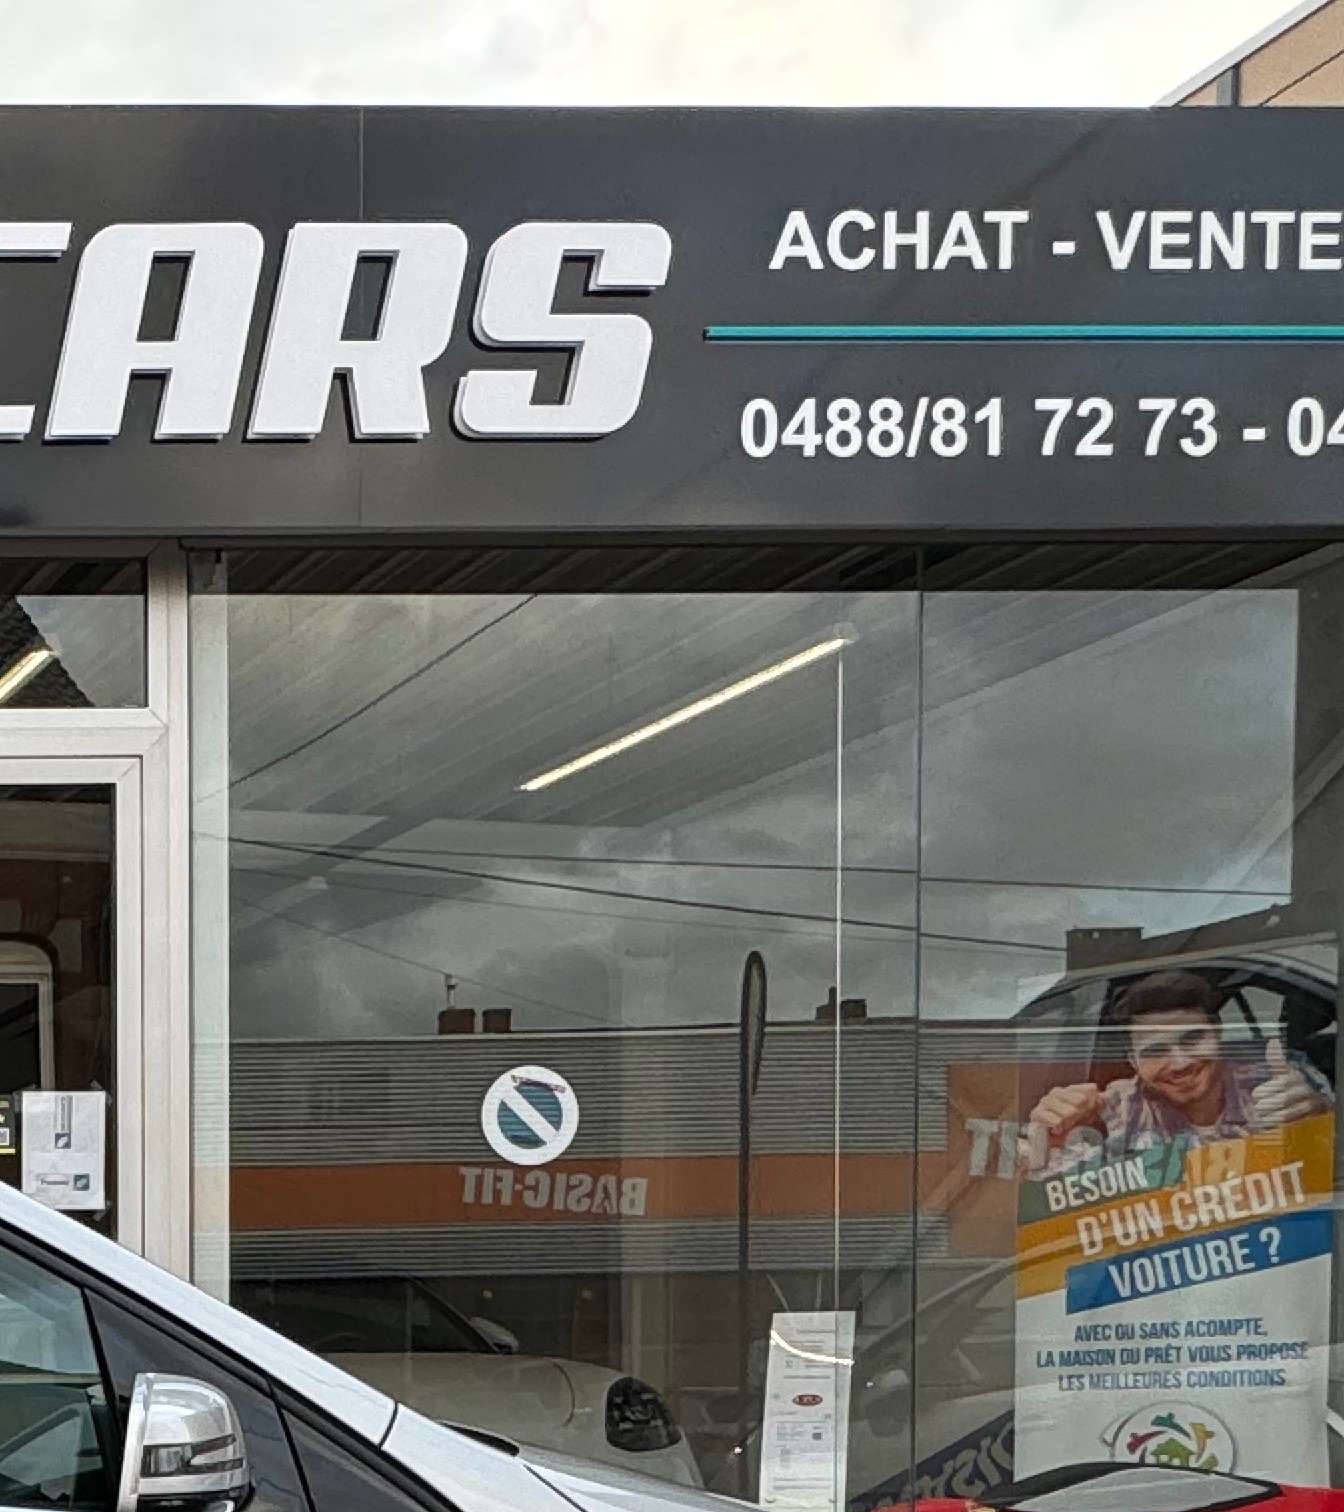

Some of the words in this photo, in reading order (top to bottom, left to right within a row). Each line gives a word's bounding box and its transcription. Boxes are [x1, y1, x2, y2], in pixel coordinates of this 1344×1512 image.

[768, 209, 1029, 271] ACHAT
[1052, 242, 1077, 256] -
[1096, 209, 1342, 271] VENTE
[739, 396, 1003, 458] 0488/81
[1033, 397, 1114, 456] 72
[1138, 397, 1218, 457] 73
[1241, 426, 1267, 442] -
[1045, 1157, 1148, 1212] BESOIN
[1076, 1198, 1164, 1256] D'UN
[1170, 1160, 1306, 1232] CRÉDIT
[1108, 1232, 1256, 1298] VOITURE
[1259, 1226, 1281, 1264] ?
[1037, 1350, 1056, 1368] LA
[1059, 1349, 1116, 1367] MAISON
[1120, 1348, 1140, 1366] DU
[1144, 1343, 1183, 1365] PRÊT
[1188, 1344, 1232, 1363] VOUS
[1236, 1340, 1308, 1361] PROPOSE
[1074, 1323, 1111, 1342] AVEC
[1115, 1322, 1136, 1340] OU
[1139, 1320, 1180, 1339] SANS
[1059, 1373, 1085, 1392] LES
[1088, 1369, 1182, 1391] MEILLEURES
[1186, 1368, 1286, 1389] CONDITIONS
